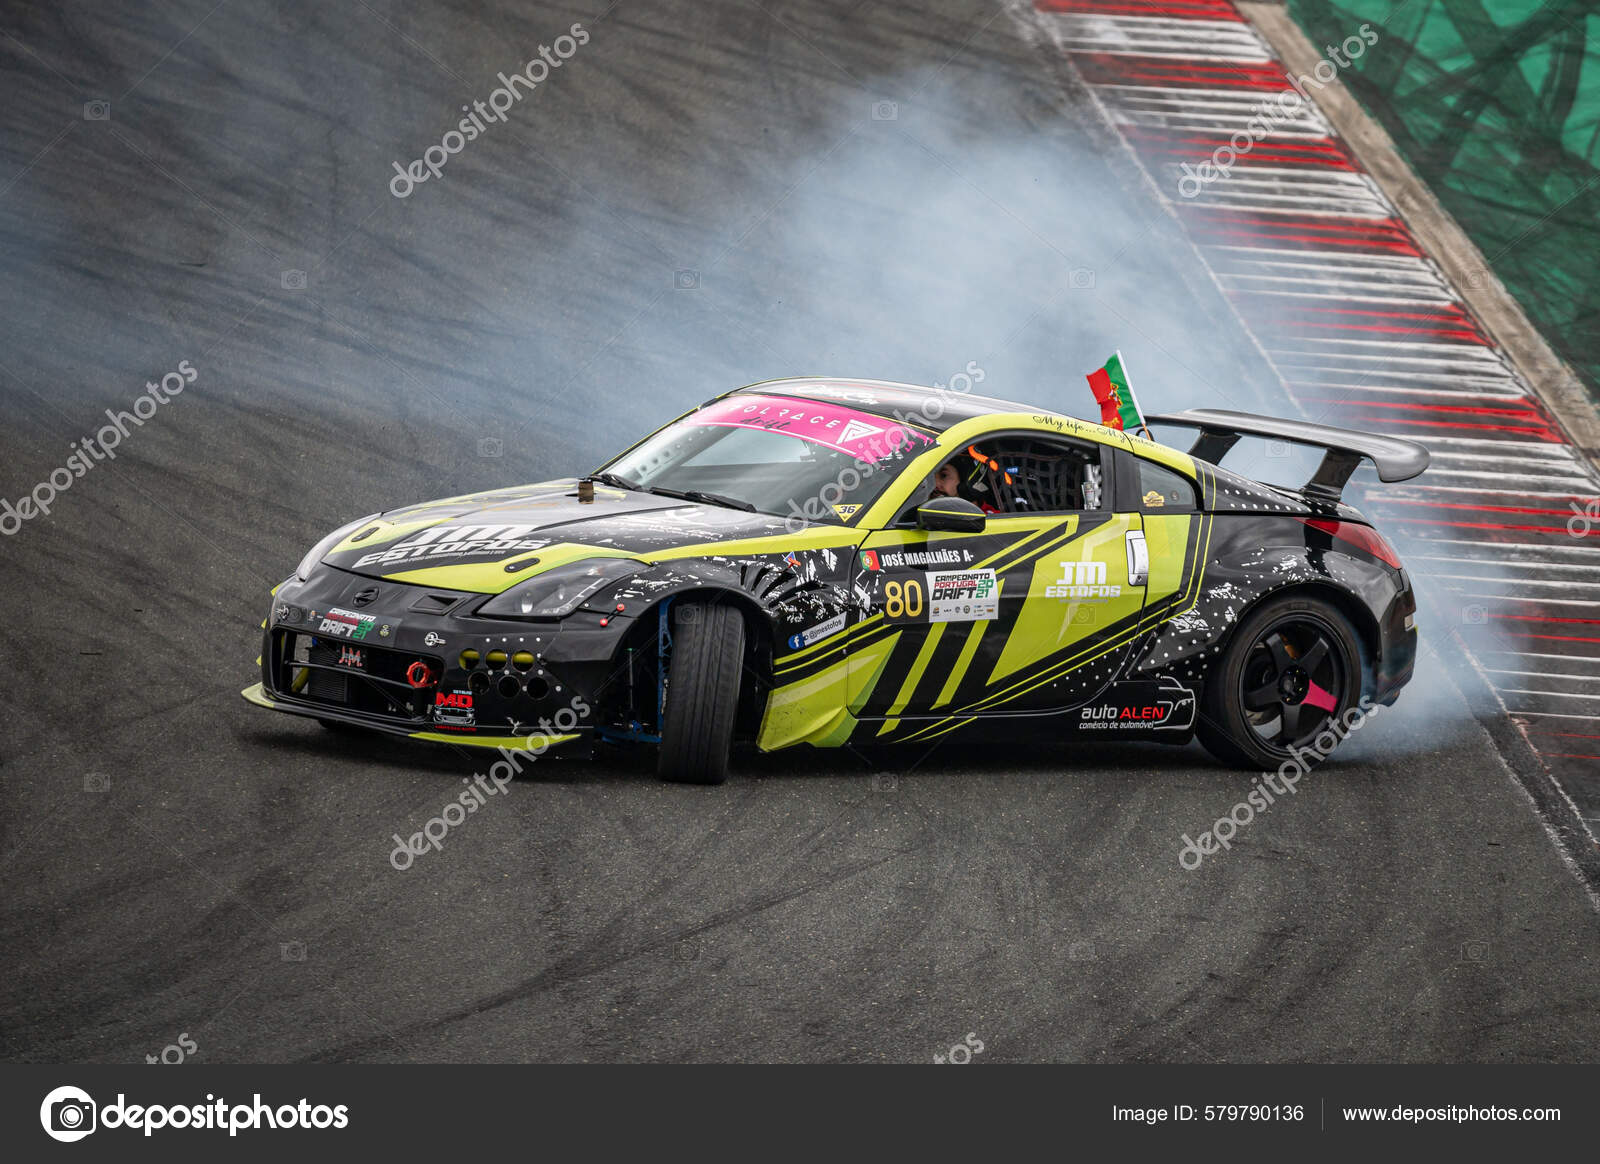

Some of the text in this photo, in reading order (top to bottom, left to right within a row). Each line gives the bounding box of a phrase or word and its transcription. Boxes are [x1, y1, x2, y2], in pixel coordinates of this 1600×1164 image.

[838, 504, 856, 514] 36
[352, 539, 551, 568] ESTOFOS
[881, 552, 905, 567] JOSÉ
[904, 549, 961, 565] MAGALHÃES
[935, 573, 990, 582] CAMPEONATO
[1056, 562, 1107, 584] JM
[934, 580, 977, 589] PORTUGAL
[1045, 585, 1121, 598] ESTOFOS
[884, 579, 923, 618] 80
[932, 587, 989, 600] DRIFT 21
[318, 619, 358, 637] DRIFT
[435, 692, 473, 708] MD
[1081, 704, 1164, 719] auto ALEN
[1079, 721, 1154, 729] comércio de automóvel
